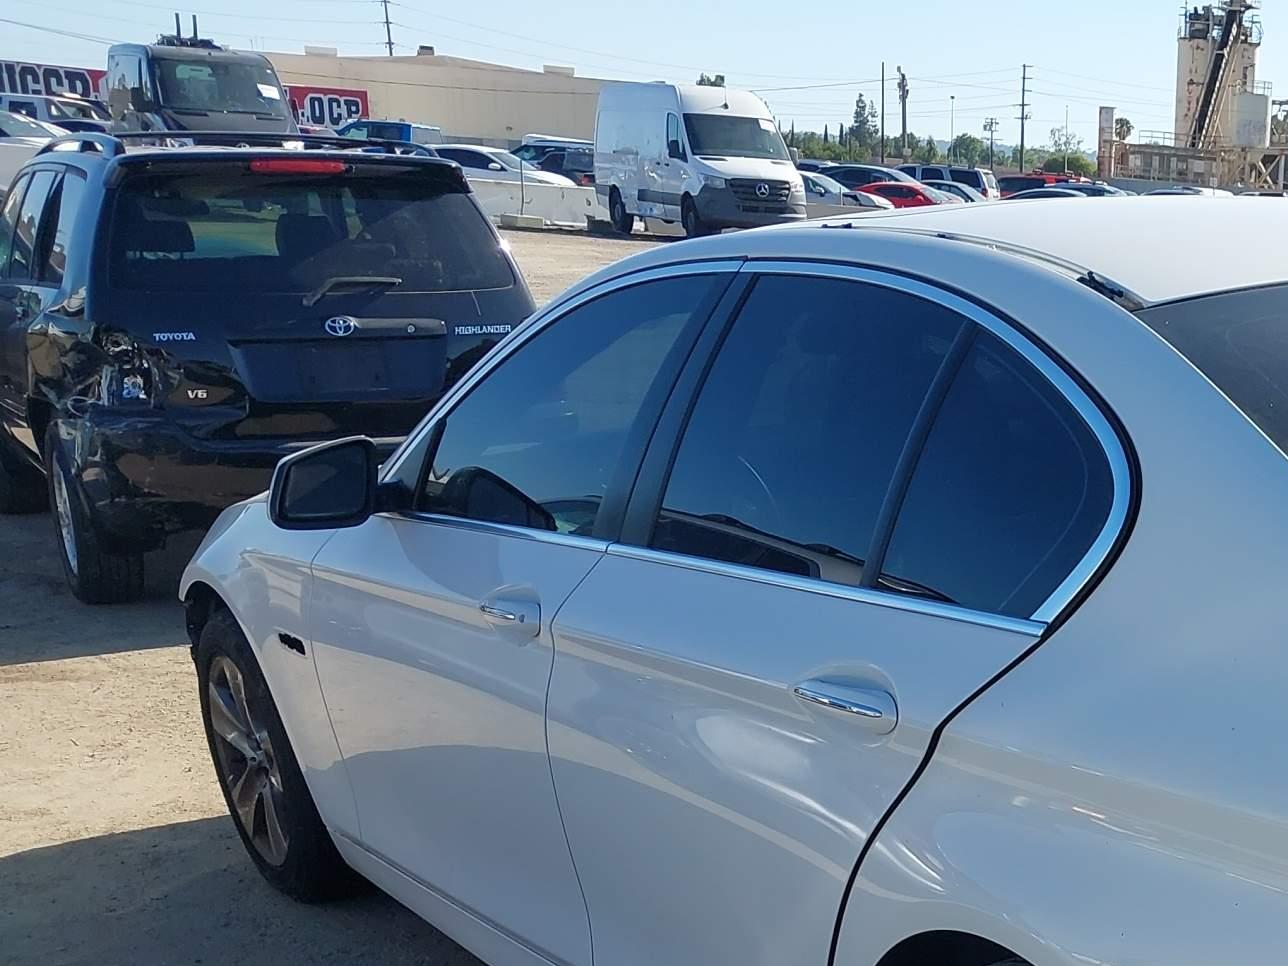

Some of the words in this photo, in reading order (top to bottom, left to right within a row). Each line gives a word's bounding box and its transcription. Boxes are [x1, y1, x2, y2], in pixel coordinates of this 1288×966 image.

[454, 324, 511, 335] HIGHLANDER
[153, 332, 196, 341] TOYOTA
[187, 389, 208, 399] V6
